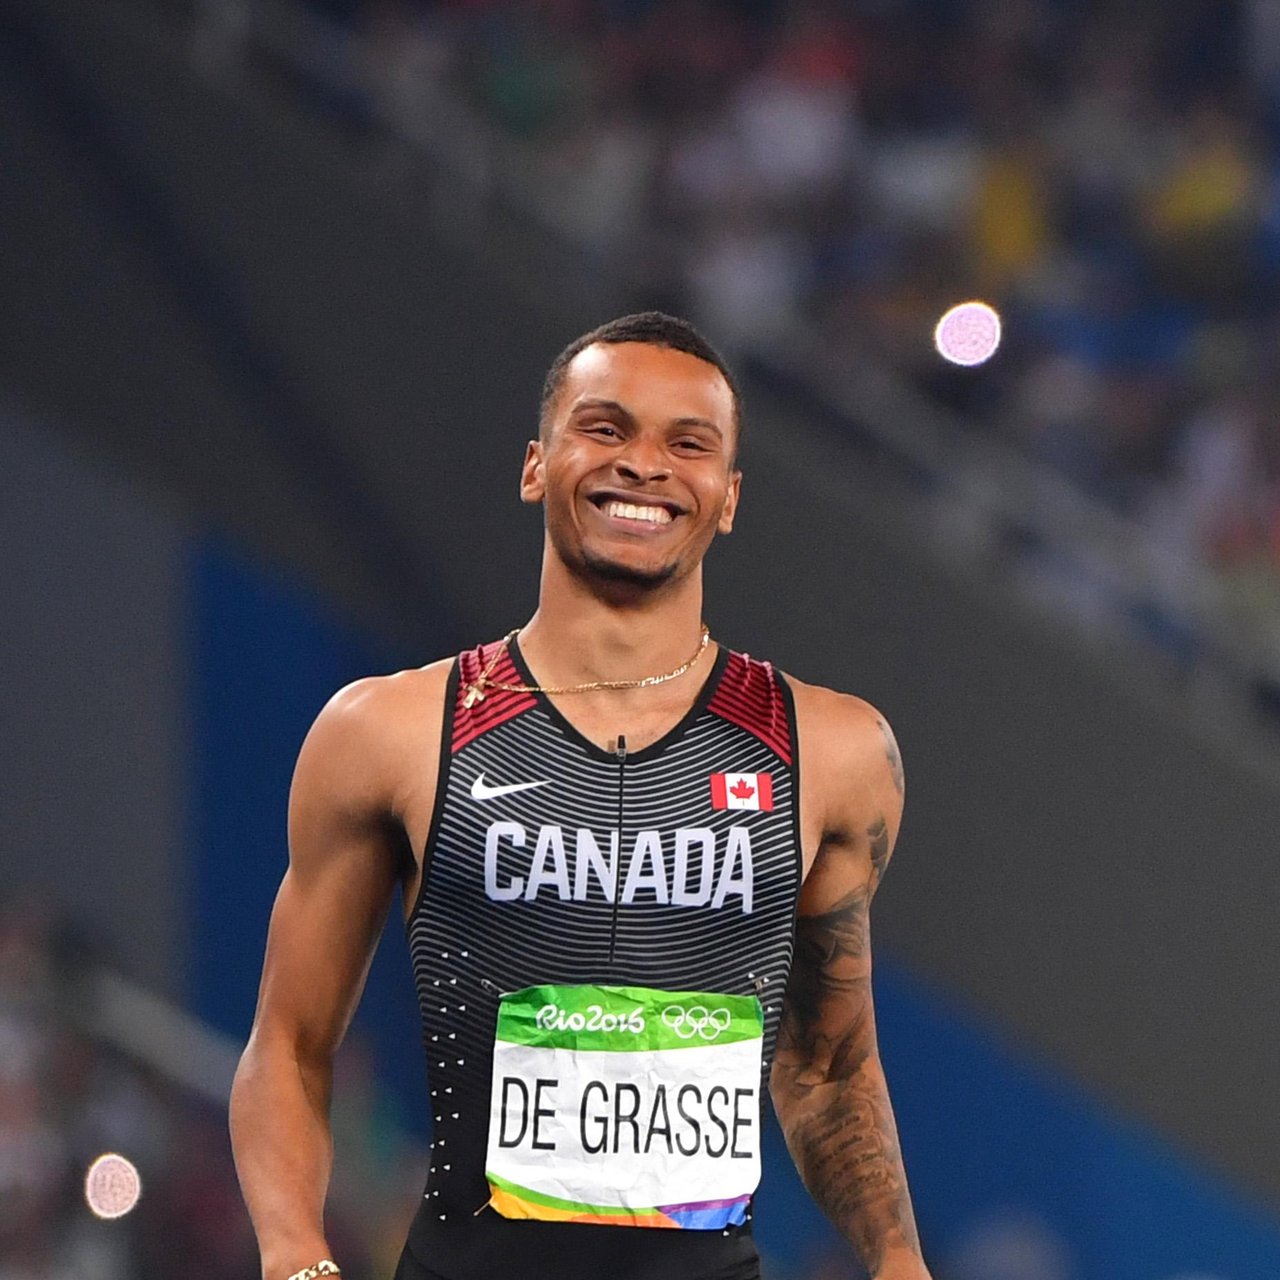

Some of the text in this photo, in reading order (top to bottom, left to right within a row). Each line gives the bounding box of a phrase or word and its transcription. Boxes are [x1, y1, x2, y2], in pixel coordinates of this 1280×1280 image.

[484, 821, 754, 914] CANADA
[536, 1003, 645, 1034] Rio2016
[497, 1075, 755, 1159] DE GRASSE
